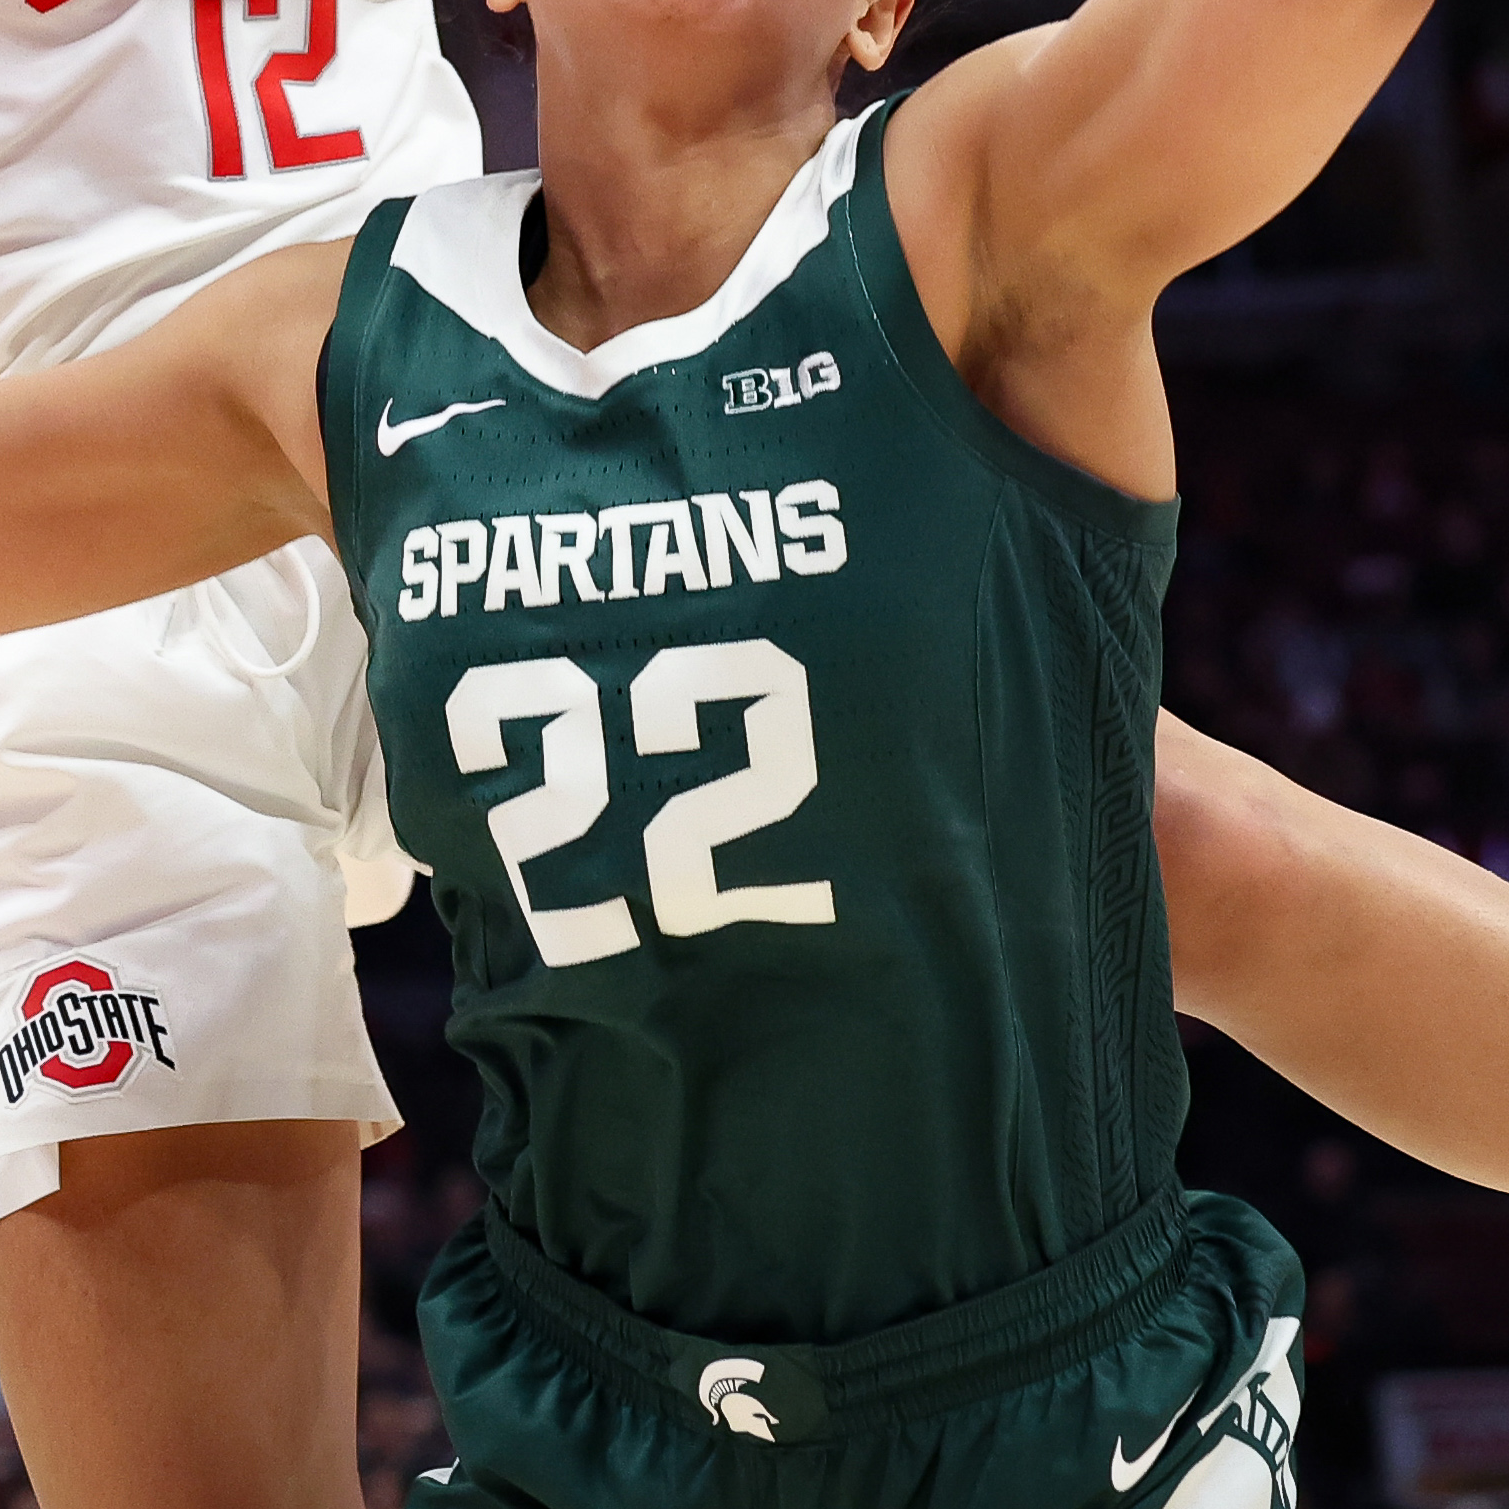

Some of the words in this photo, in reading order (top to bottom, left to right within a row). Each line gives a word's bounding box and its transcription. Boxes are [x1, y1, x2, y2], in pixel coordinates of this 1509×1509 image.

[398, 479, 848, 622] SPARTANS
[445, 638, 837, 968] 22
[56, 992, 176, 1071] STATE
